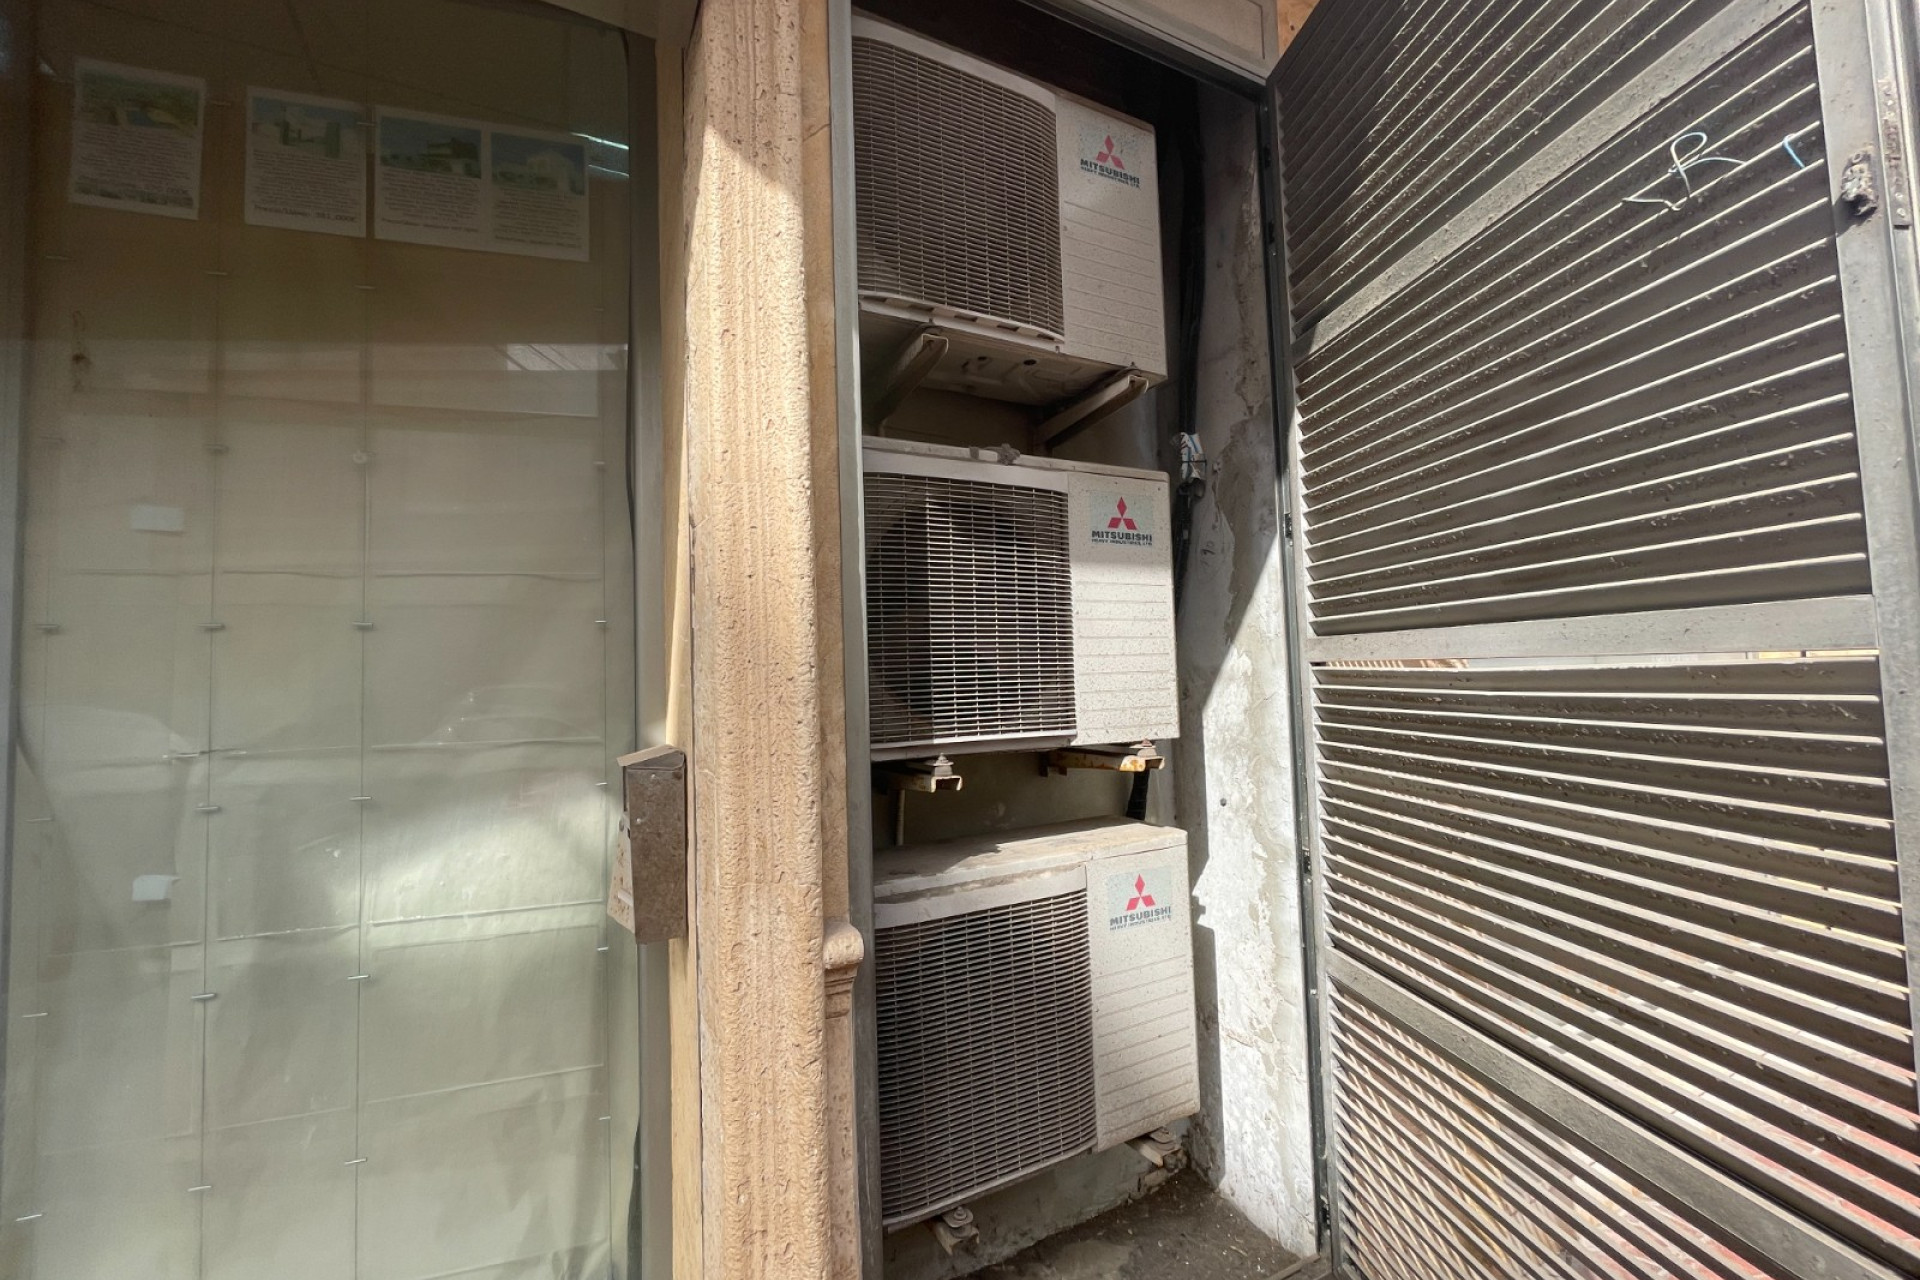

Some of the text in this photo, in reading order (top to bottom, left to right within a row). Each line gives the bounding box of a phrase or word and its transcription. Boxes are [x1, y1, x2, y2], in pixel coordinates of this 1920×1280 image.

[1080, 158, 1140, 184] MITSUBISHI
[1091, 531, 1153, 542] MITSUBISHI
[1109, 906, 1171, 926] MITSUBISHI
